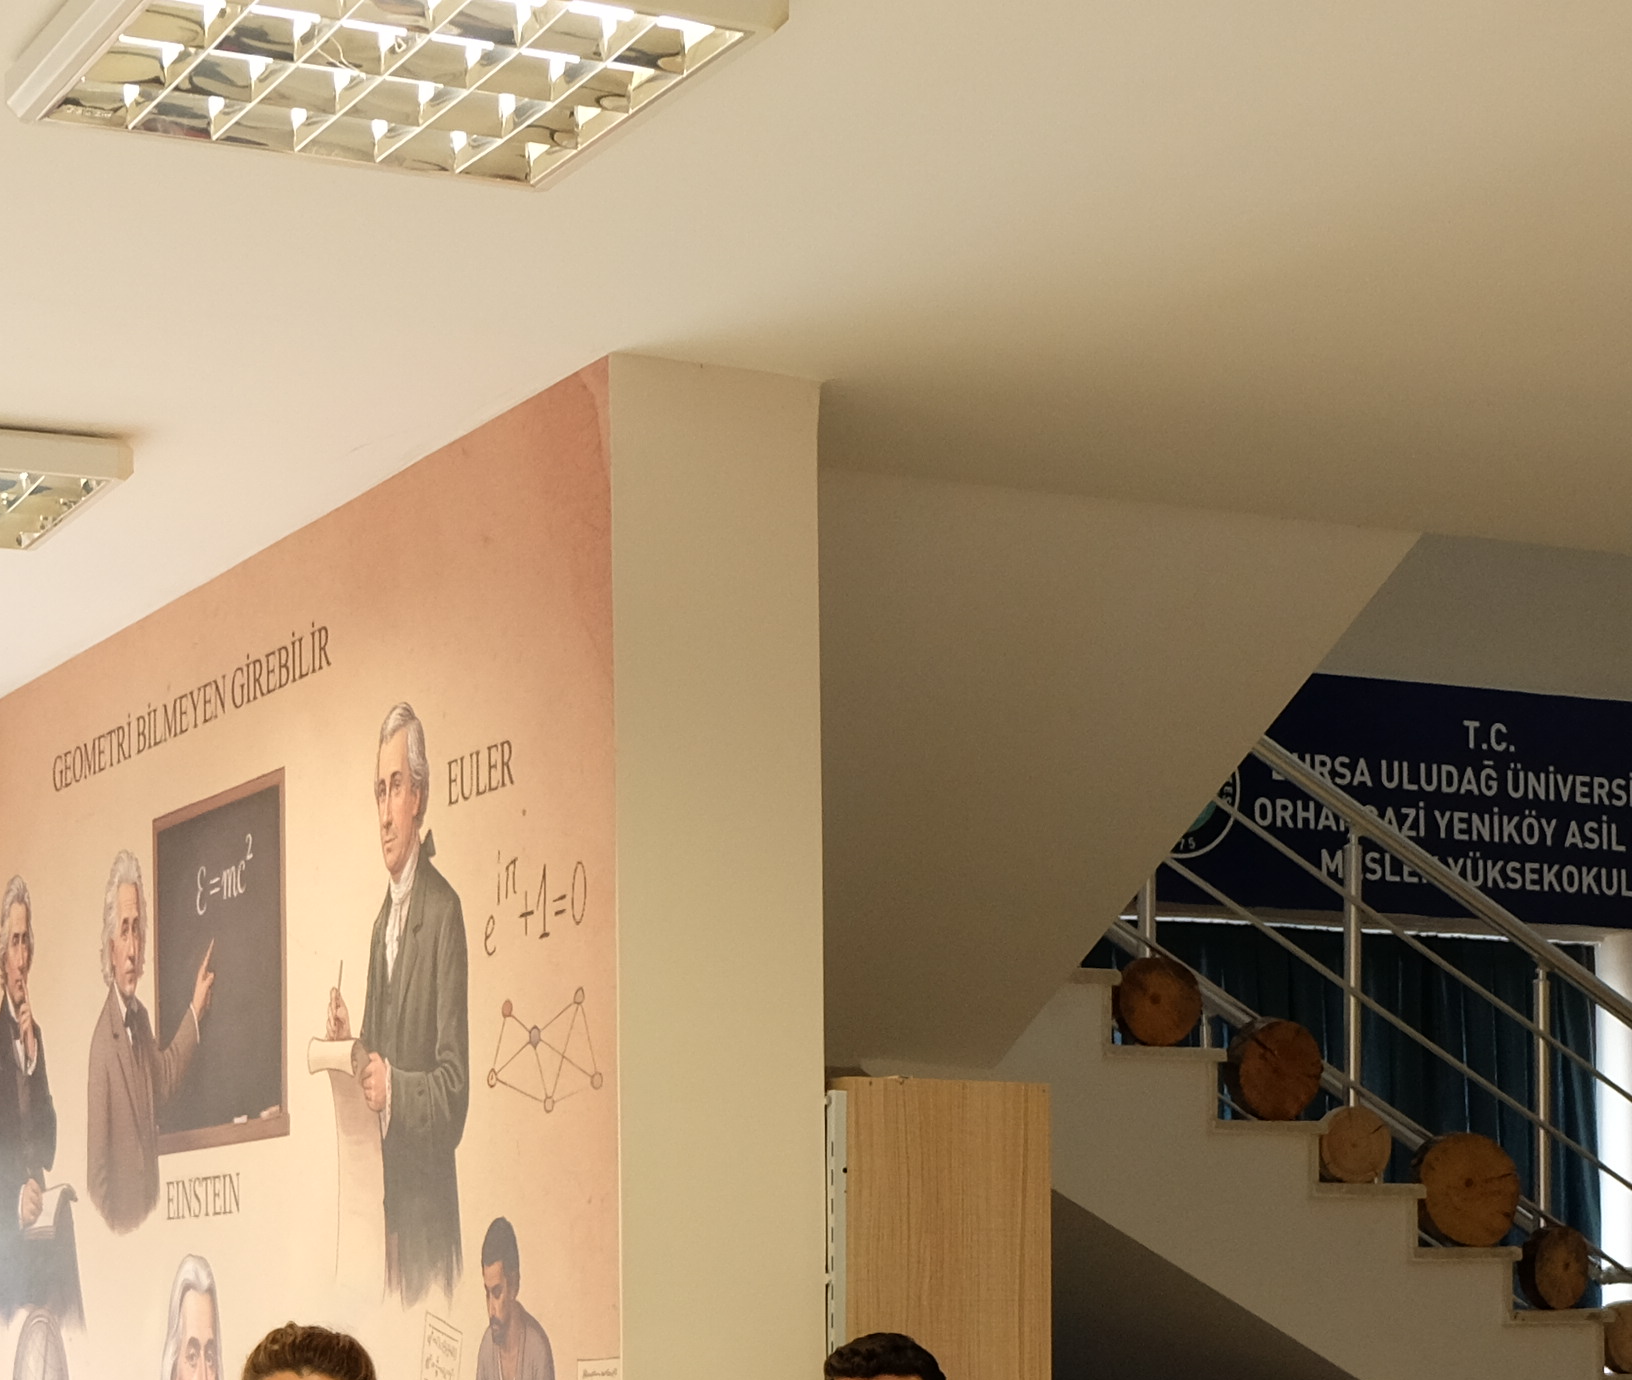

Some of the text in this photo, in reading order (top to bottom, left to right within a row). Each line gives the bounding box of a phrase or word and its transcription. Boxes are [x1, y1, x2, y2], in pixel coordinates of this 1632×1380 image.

[52, 621, 332, 793] GEOMETRİ BİLMEYEN GİREBİLİR
[1462, 719, 1515, 753] T.C.
[447, 739, 514, 806] EULER
[1271, 751, 1373, 788] RSA
[1380, 757, 1498, 799] ULUDAĞ
[1435, 810, 1559, 849] YENİKÖY
[1564, 811, 1626, 855] ASİL
[1320, 847, 1440, 885] MSLE
[166, 1172, 241, 1221] EINSTEIN
